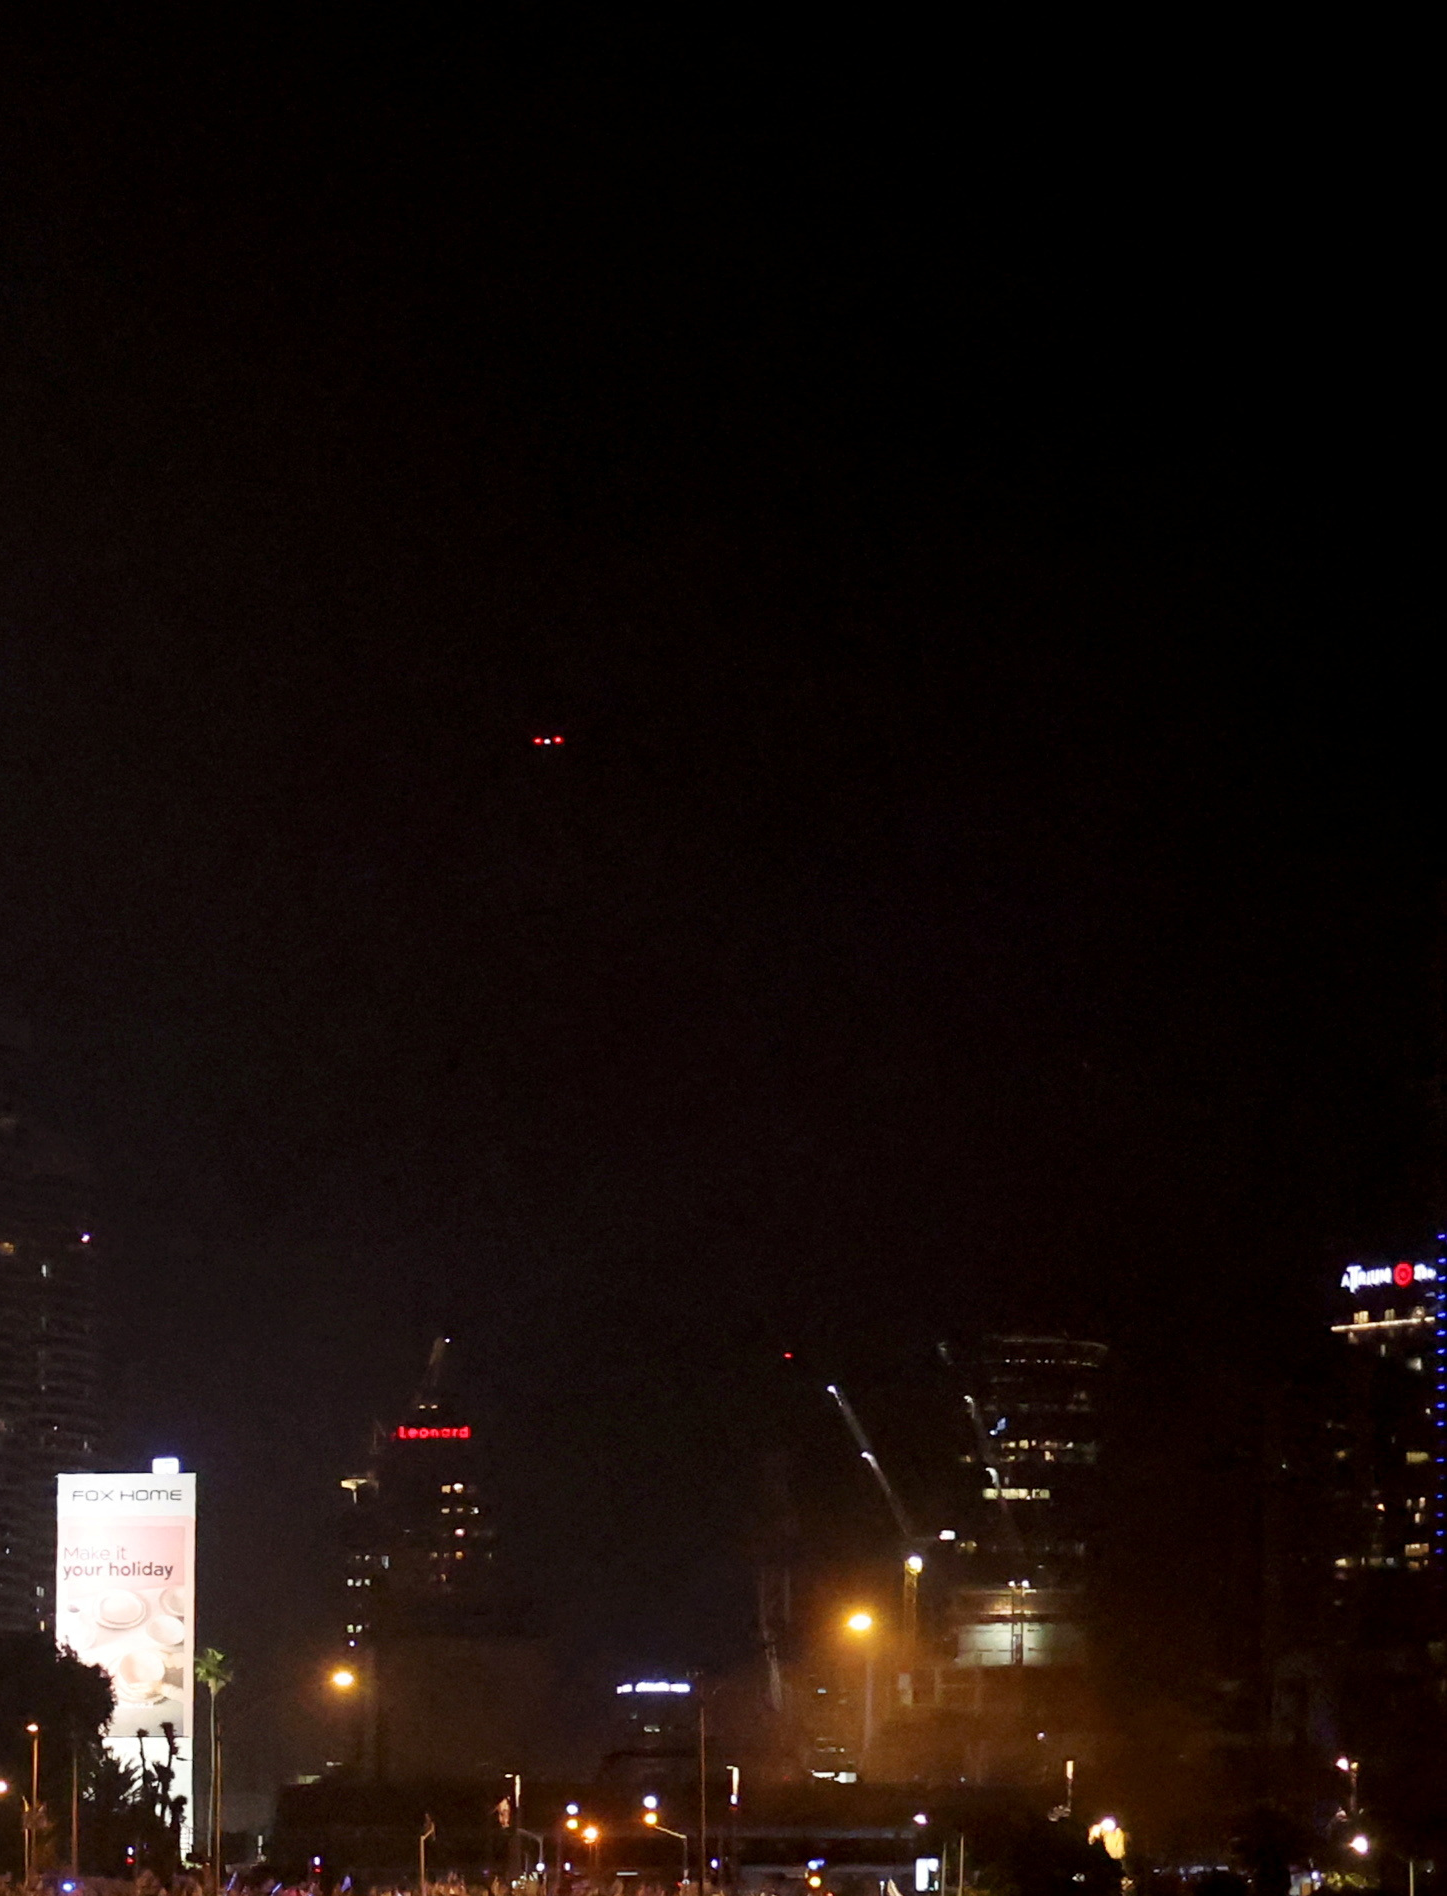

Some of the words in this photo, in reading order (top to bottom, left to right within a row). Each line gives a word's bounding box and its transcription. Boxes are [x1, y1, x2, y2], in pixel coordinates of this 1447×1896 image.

[72, 1488, 114, 1502] FOX
[120, 1488, 183, 1502] HOME
[63, 1545, 111, 1562] Make
[114, 1545, 127, 1562] it
[62, 1564, 103, 1581] your
[109, 1561, 174, 1580] holiday
